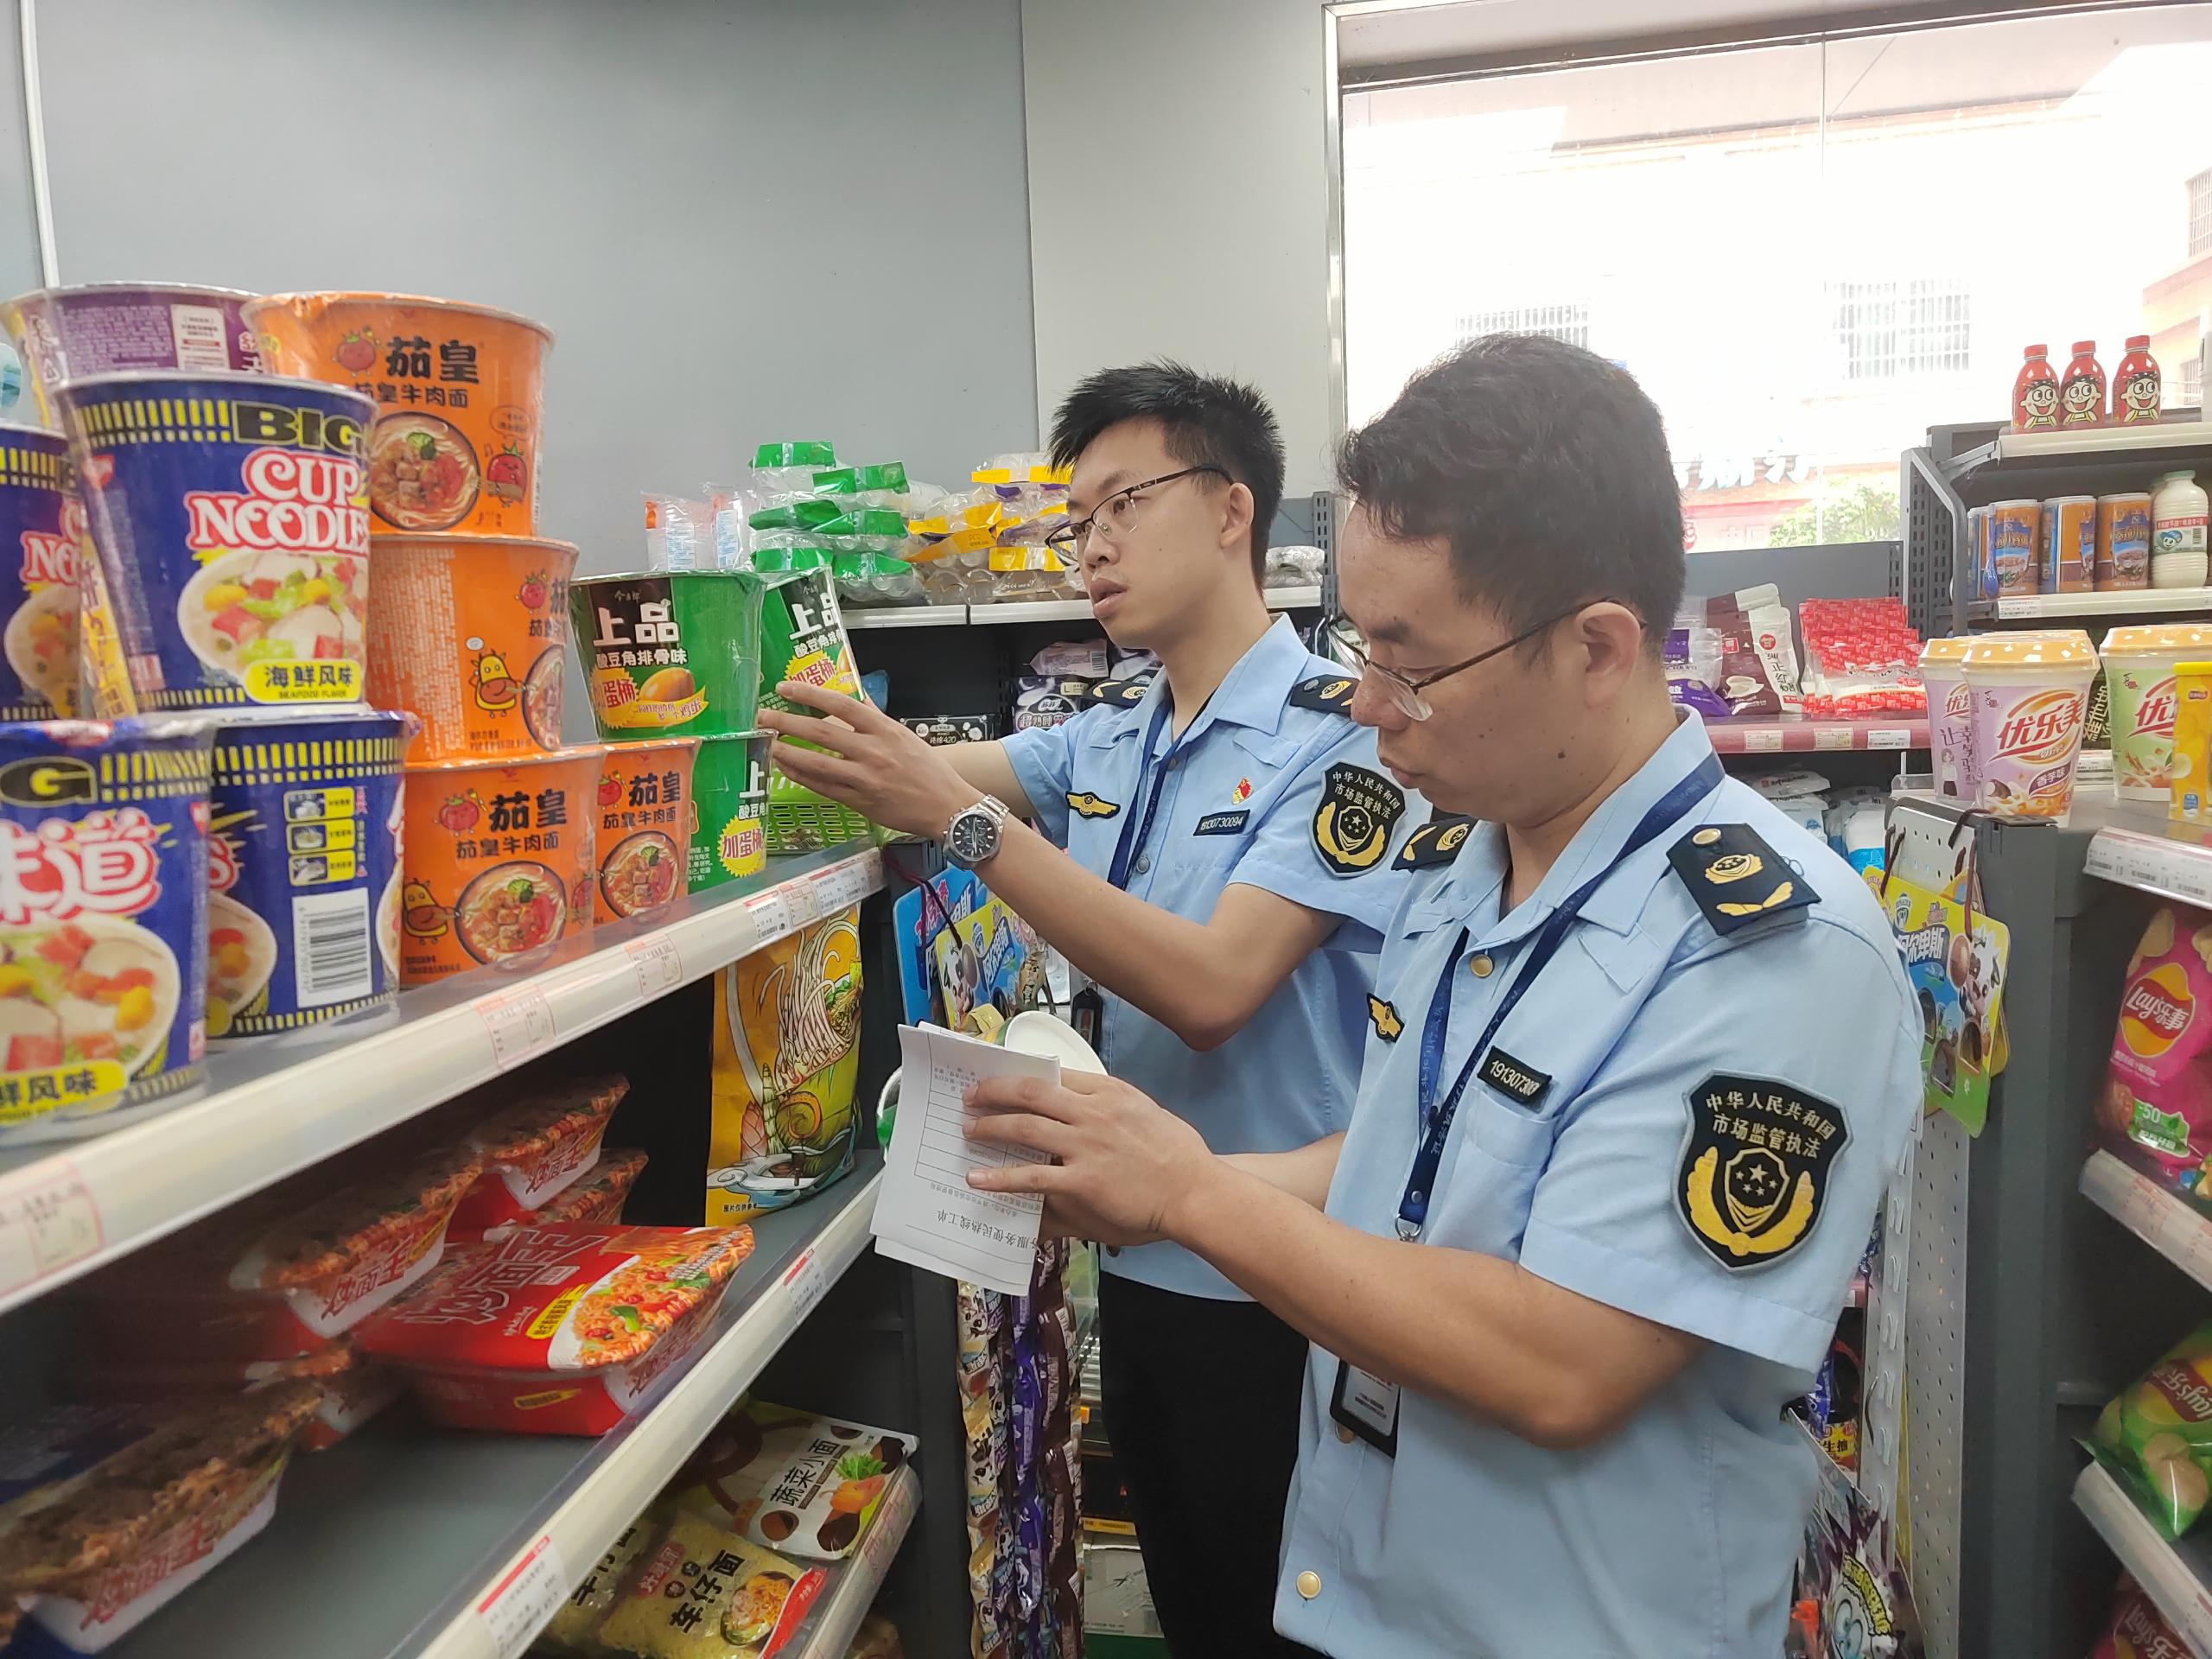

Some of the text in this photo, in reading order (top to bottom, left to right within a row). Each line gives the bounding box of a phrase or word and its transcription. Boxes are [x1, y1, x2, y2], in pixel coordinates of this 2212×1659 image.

[385, 335, 480, 385] 茄皇
[232, 400, 365, 457] BIG
[245, 448, 359, 506] CUP
[593, 598, 680, 647] 上品
[264, 665, 353, 688] 海鲜风味
[1997, 692, 2085, 749] 优乐美
[488, 789, 568, 833] 茄皇
[628, 771, 681, 808] 茄皇
[1332, 771, 1401, 810] 中华人民共和国
[1334, 783, 1392, 820] 市场监管执法
[602, 806, 677, 830] 茄皇牛肉面
[455, 831, 560, 859] 茄皇牛肉面
[721, 828, 764, 860] 加蛋桶
[982, 919, 1010, 988] 阿尔卑斯
[1706, 1090, 1837, 1141] 中华人民共和国
[1712, 1113, 1821, 1160] 市场监管执法
[769, 1438, 841, 1507] 蔬菜小面
[669, 1549, 747, 1633] 车仔面
